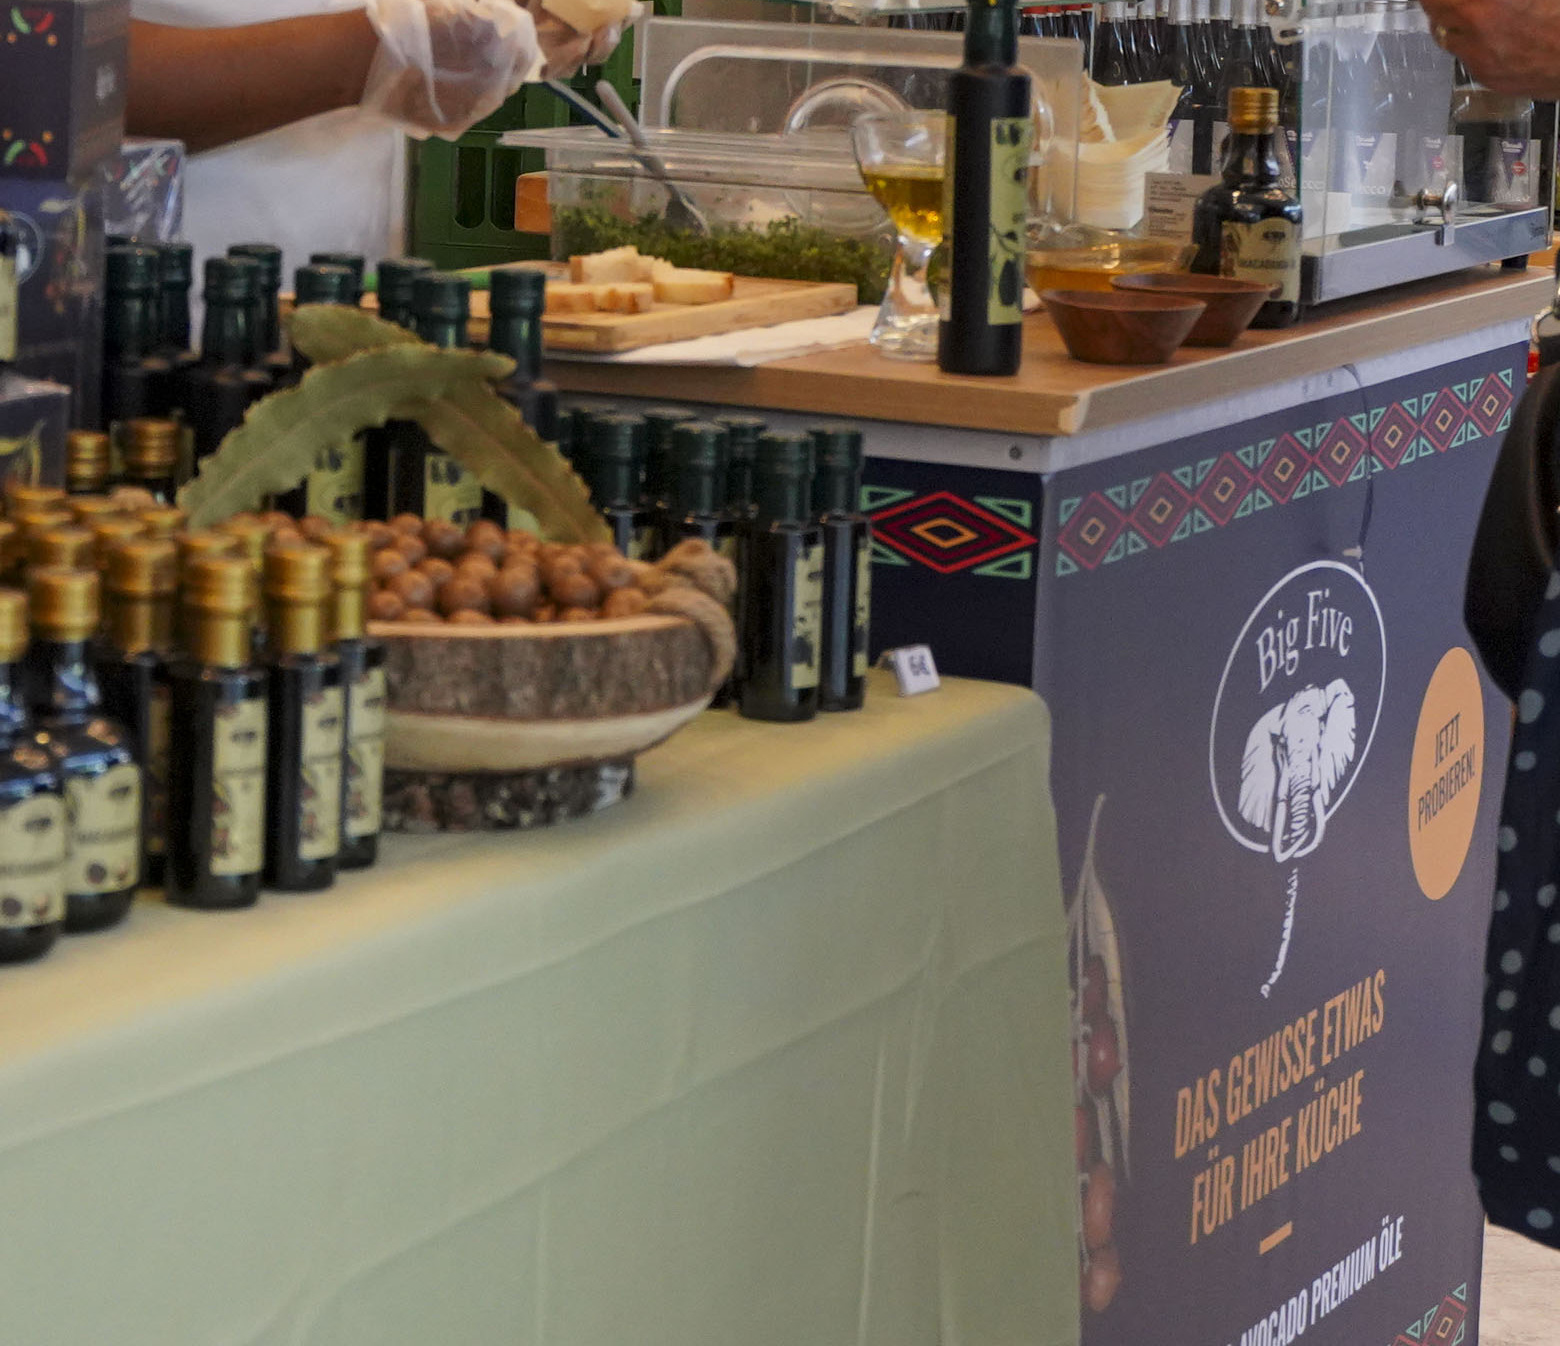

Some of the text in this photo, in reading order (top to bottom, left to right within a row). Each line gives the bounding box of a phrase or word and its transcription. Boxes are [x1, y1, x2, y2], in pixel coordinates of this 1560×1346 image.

[1256, 588, 1353, 694] Big Five
[1418, 744, 1476, 832] PROBIEREN!
[1435, 711, 1460, 769] JETZT
[1175, 969, 1385, 1160] DAS GEWISSE ETWAS
[1191, 1069, 1365, 1246] FÜR IHRE KÜCHE
[1310, 1235, 1377, 1326] PREMIUM
[1378, 1214, 1405, 1273] ÖLE
